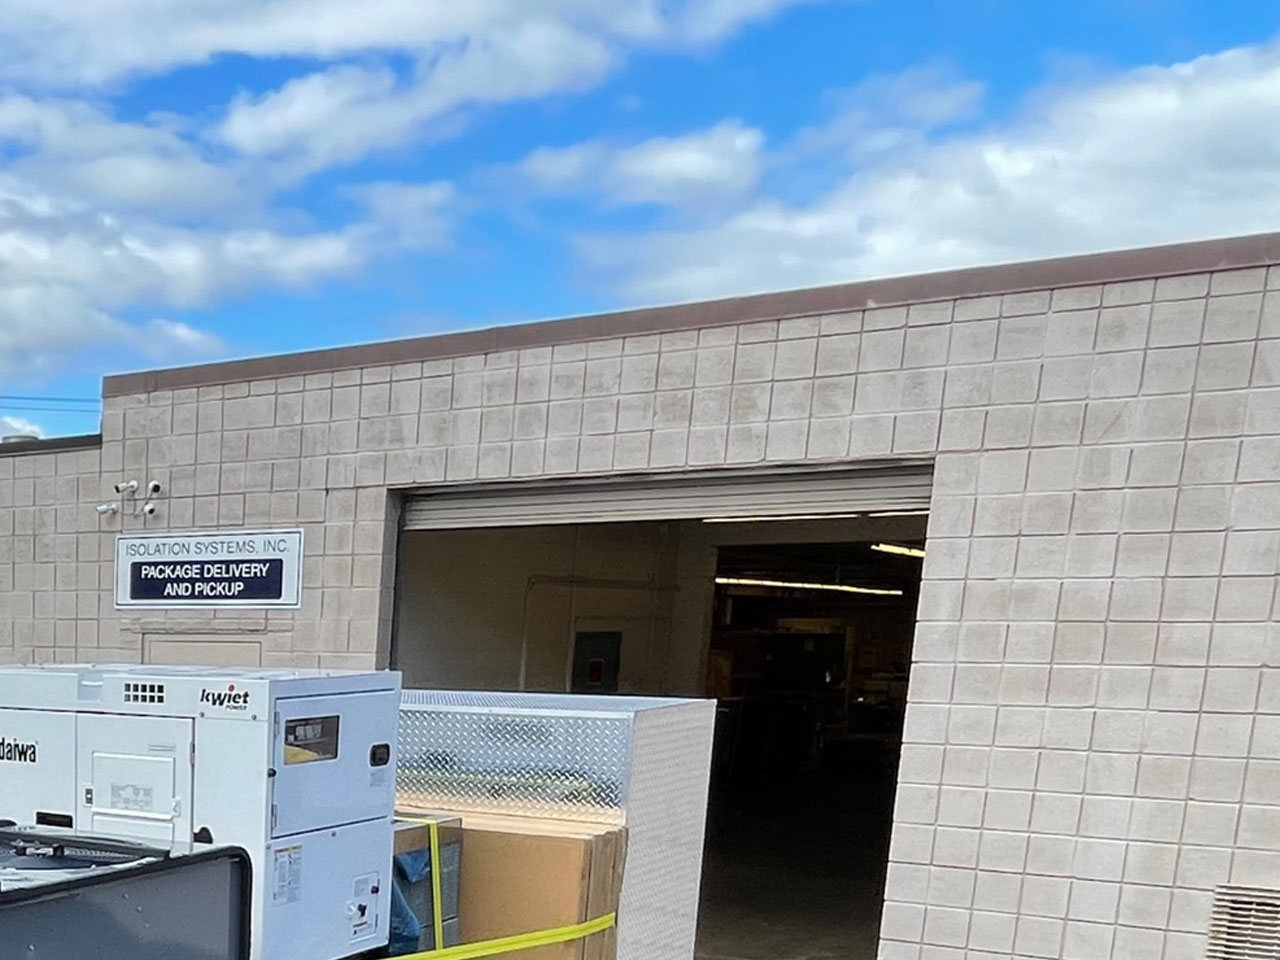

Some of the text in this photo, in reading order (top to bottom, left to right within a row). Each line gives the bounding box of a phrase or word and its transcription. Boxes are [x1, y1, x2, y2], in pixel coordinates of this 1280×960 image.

[125, 538, 290, 557] ISOLATION SYSTEMS, INC.
[141, 563, 270, 579] PACKAGE DELIVERY
[163, 582, 245, 596] AND PICKUP
